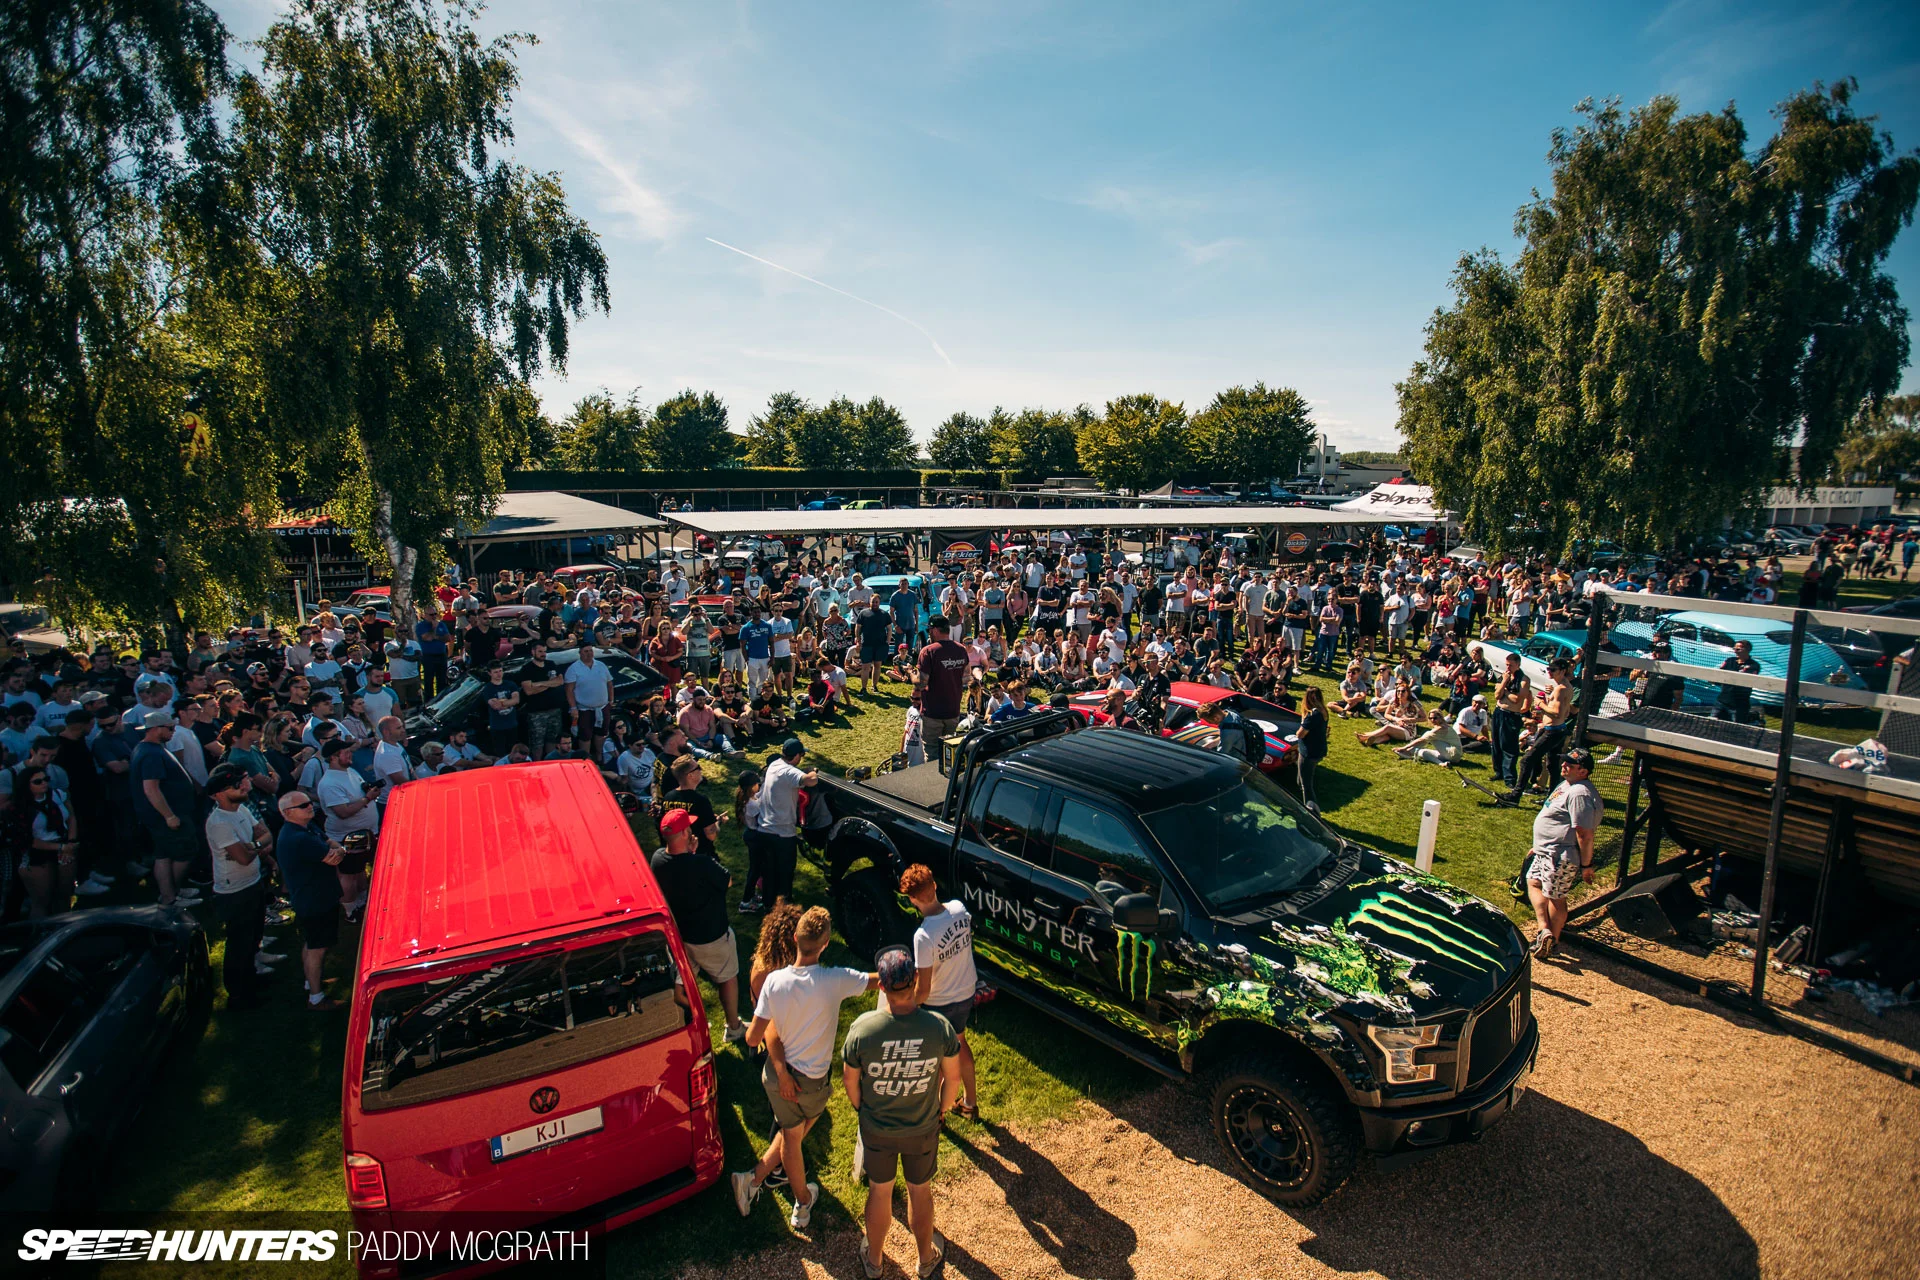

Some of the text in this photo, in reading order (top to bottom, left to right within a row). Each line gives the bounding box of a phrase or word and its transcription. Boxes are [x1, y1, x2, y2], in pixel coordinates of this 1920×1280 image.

[1828, 490, 1865, 505] CIRCUIT
[288, 527, 305, 536] Car
[307, 526, 330, 535] Care
[963, 881, 1099, 963] MONSTER
[937, 926, 955, 949] LIVE
[984, 917, 1079, 969] ENERGY
[938, 941, 961, 961] DRIVE
[881, 1038, 924, 1060] THE
[867, 1057, 938, 1079] OTHER
[872, 1076, 932, 1097] GUYS
[536, 1119, 566, 1143] KJI
[494, 1148, 502, 1158] B
